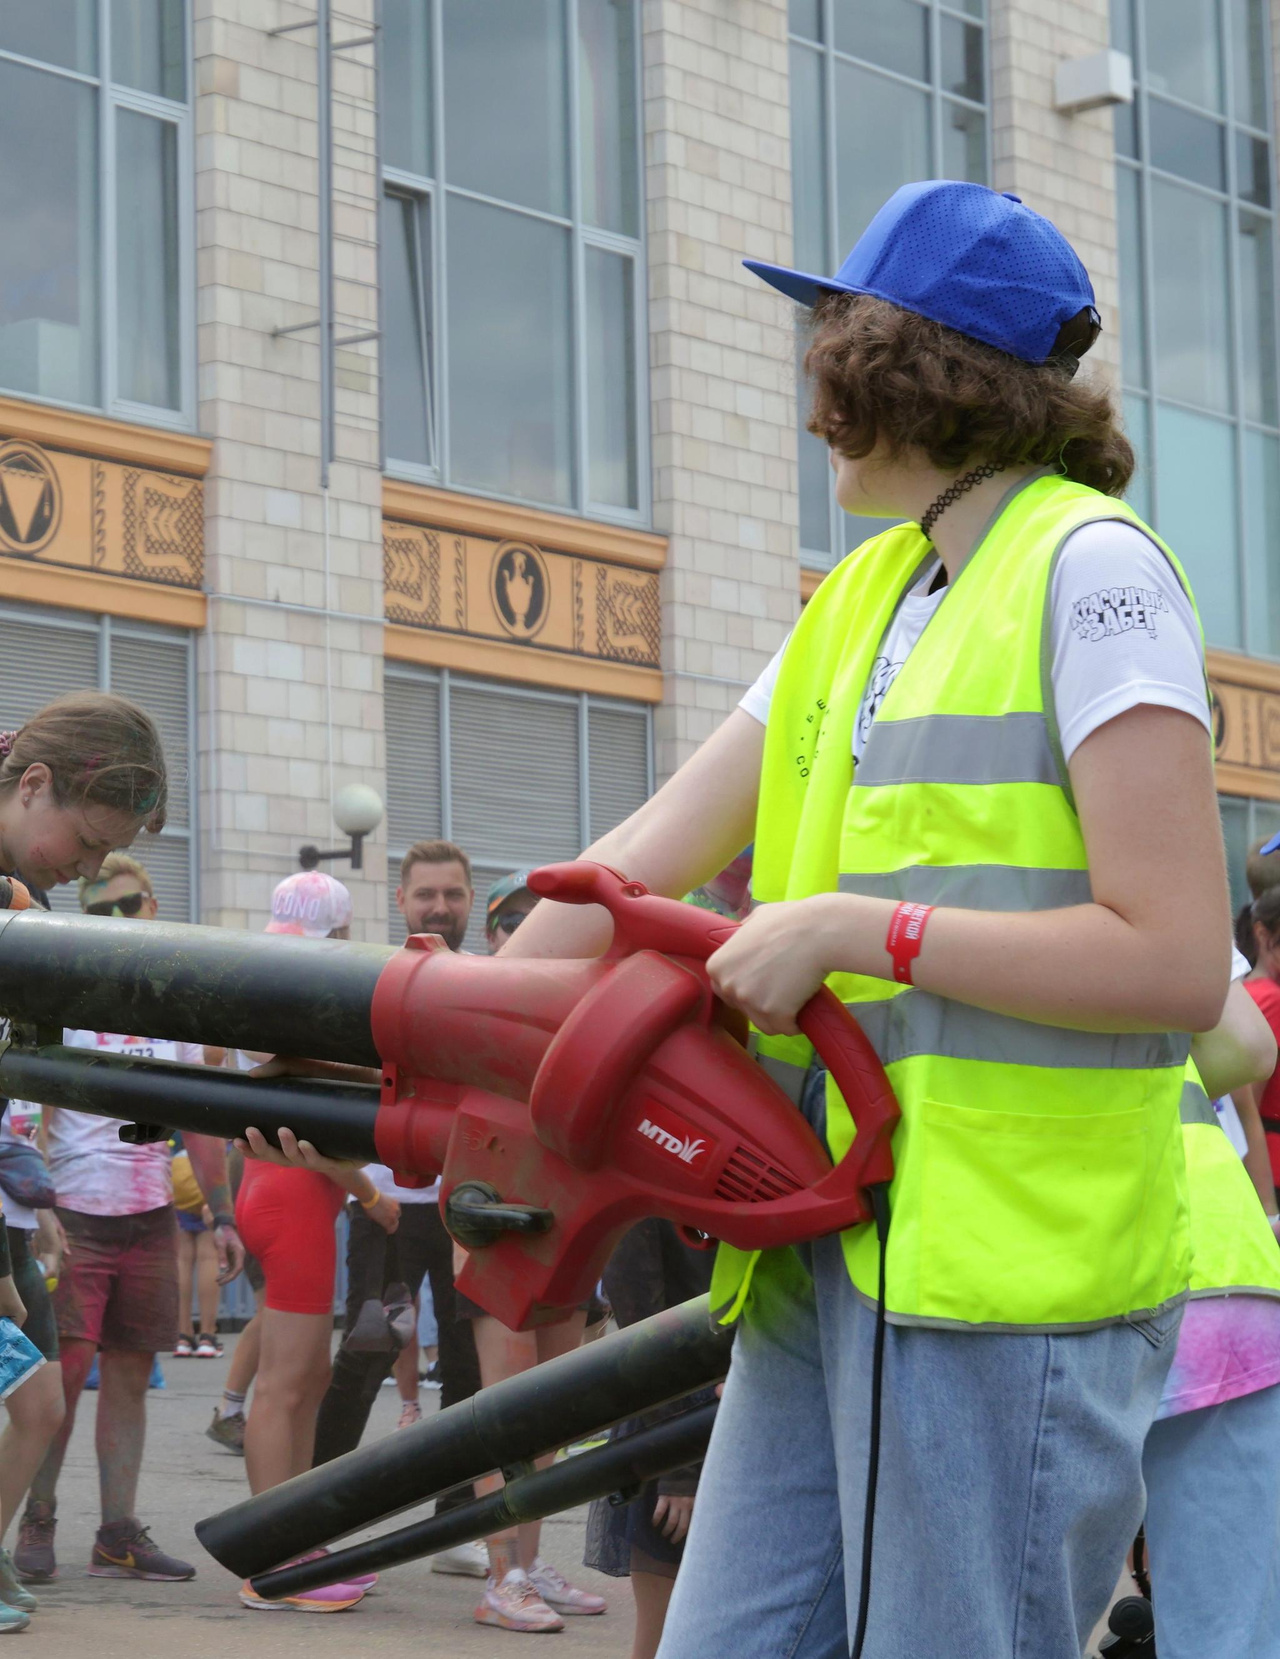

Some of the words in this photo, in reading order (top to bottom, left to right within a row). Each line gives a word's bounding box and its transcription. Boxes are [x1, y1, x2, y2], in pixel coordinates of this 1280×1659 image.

[1069, 586, 1169, 631] КРАСОЧНЫЙ
[1086, 604, 1157, 642] ЗАБЕГ
[637, 1118, 684, 1155] MTD
